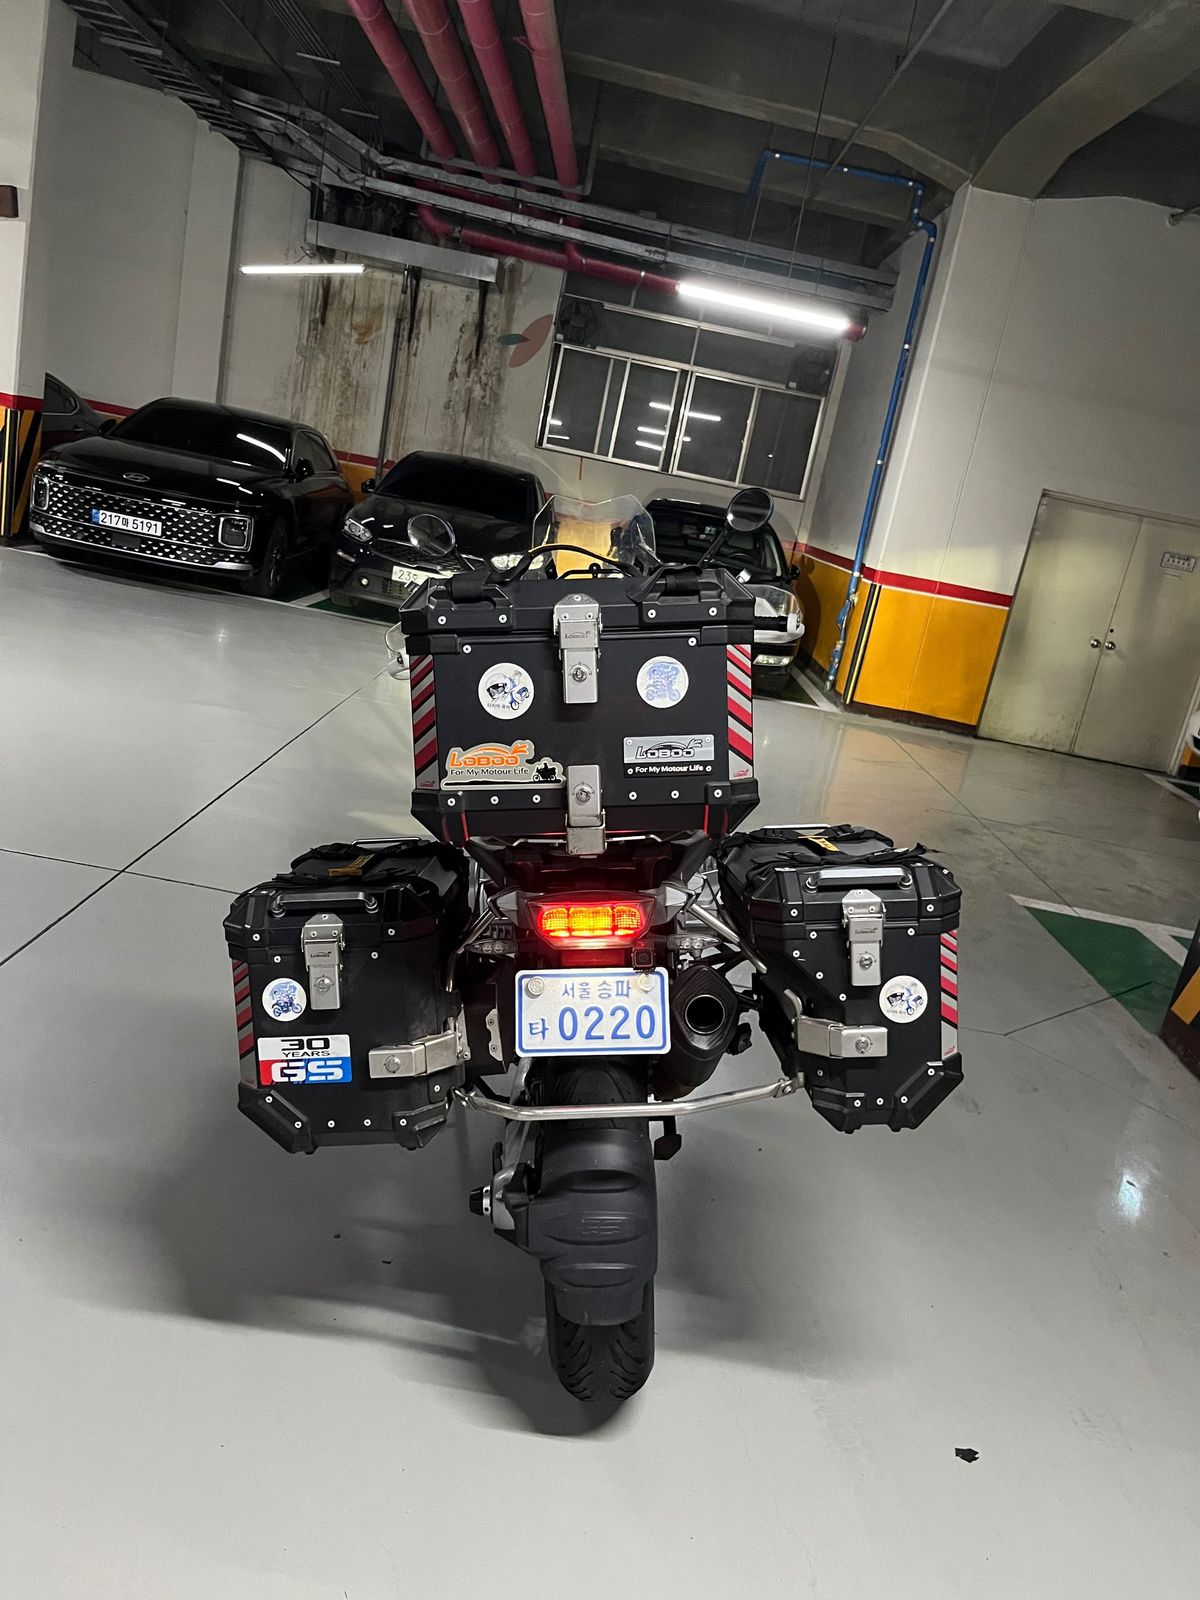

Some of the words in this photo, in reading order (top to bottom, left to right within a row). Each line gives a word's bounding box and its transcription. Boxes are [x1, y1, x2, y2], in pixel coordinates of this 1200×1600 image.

[101, 512, 130, 528] 217마
[132, 519, 158, 534] 5191
[449, 749, 523, 767] LOBOO
[513, 767, 529, 775] Life
[649, 766, 660, 774] My
[661, 765, 688, 773] Motour
[689, 764, 704, 772] Life
[562, 981, 592, 999] 서울
[597, 979, 631, 999] 송파
[528, 1017, 550, 1041] 타
[558, 1004, 656, 1041] 0220
[280, 1037, 330, 1051] 30
[282, 1050, 331, 1058] YEARS
[271, 1060, 344, 1082] GS
